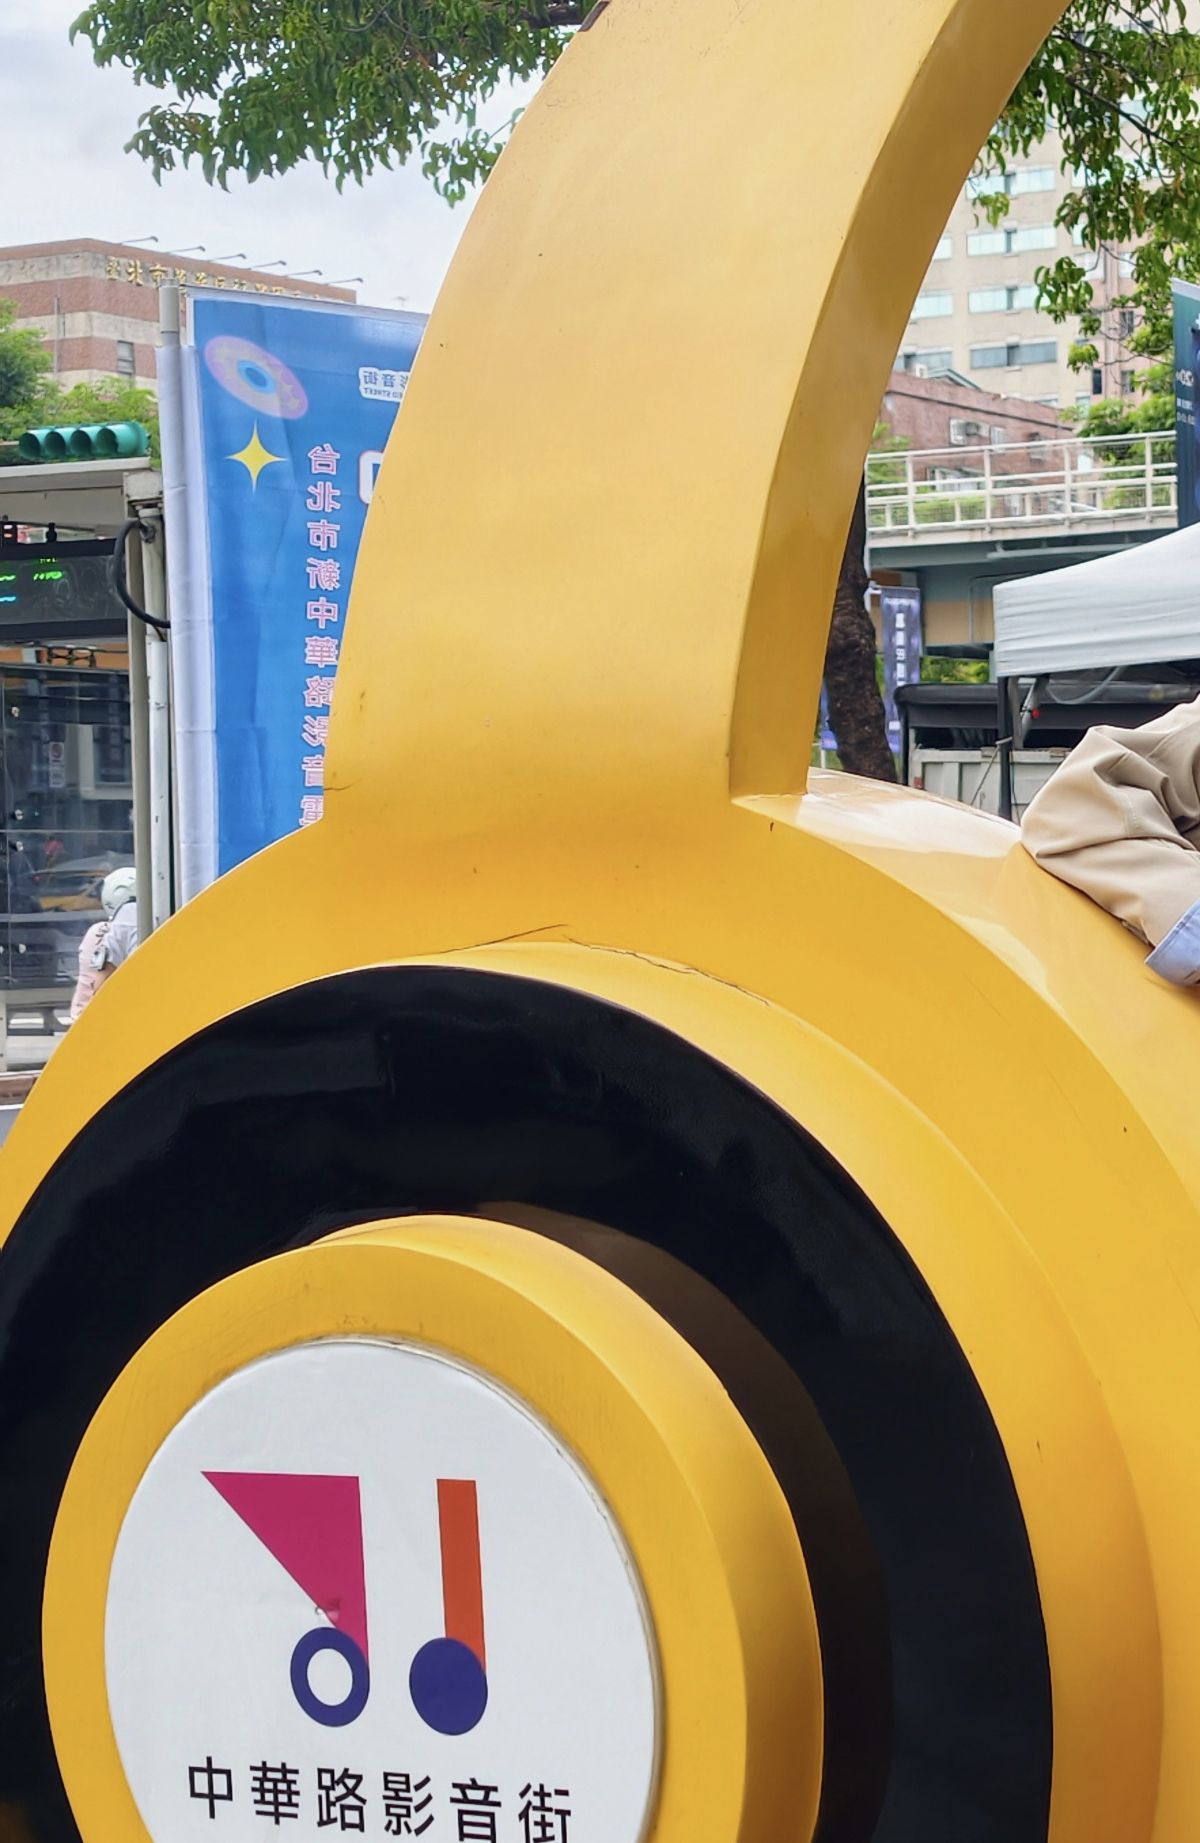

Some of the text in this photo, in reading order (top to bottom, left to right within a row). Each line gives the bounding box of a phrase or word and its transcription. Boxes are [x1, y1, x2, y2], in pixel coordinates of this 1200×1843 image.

[187, 1756, 572, 1843] 中華路影音街
